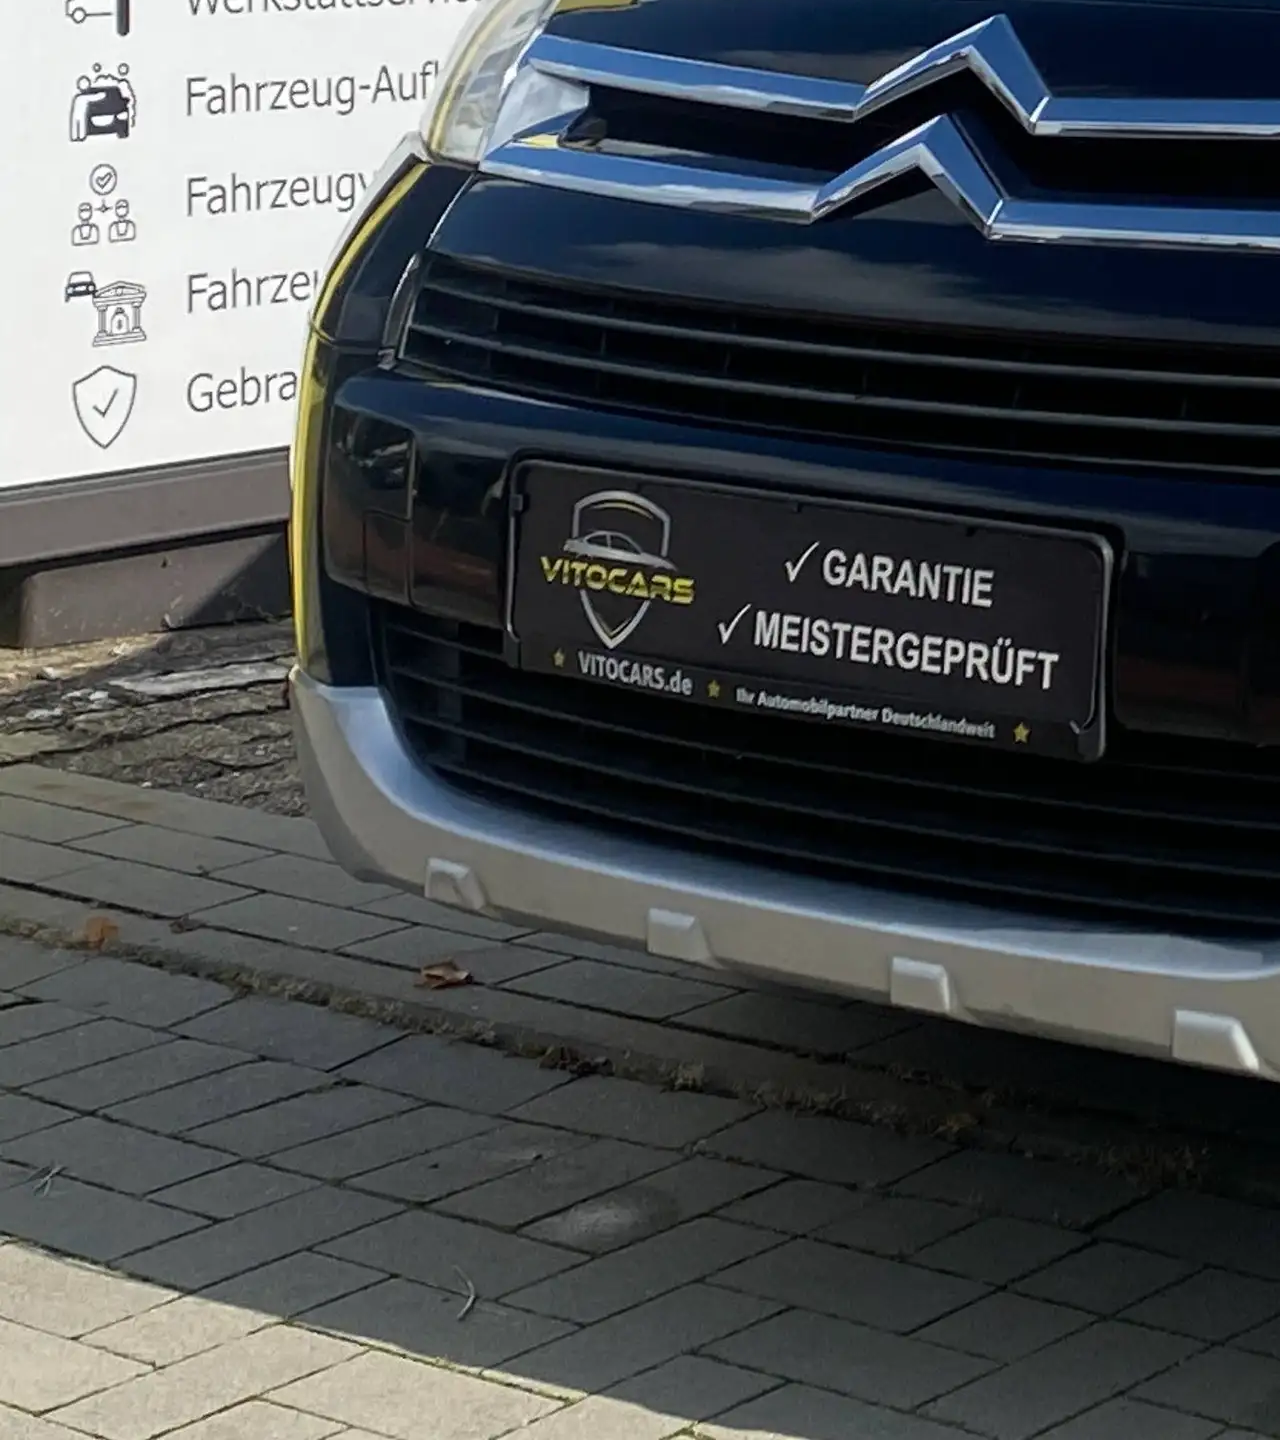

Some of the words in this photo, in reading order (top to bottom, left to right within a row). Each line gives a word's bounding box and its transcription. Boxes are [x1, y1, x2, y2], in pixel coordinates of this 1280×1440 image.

[187, 171, 369, 216] Fahrzeug
[541, 556, 694, 604] VITOCARS
[823, 548, 994, 608] GARANTIE
[578, 650, 693, 697] VITOCARS.de
[754, 610, 1059, 691] MEISTERGEPRÜFT
